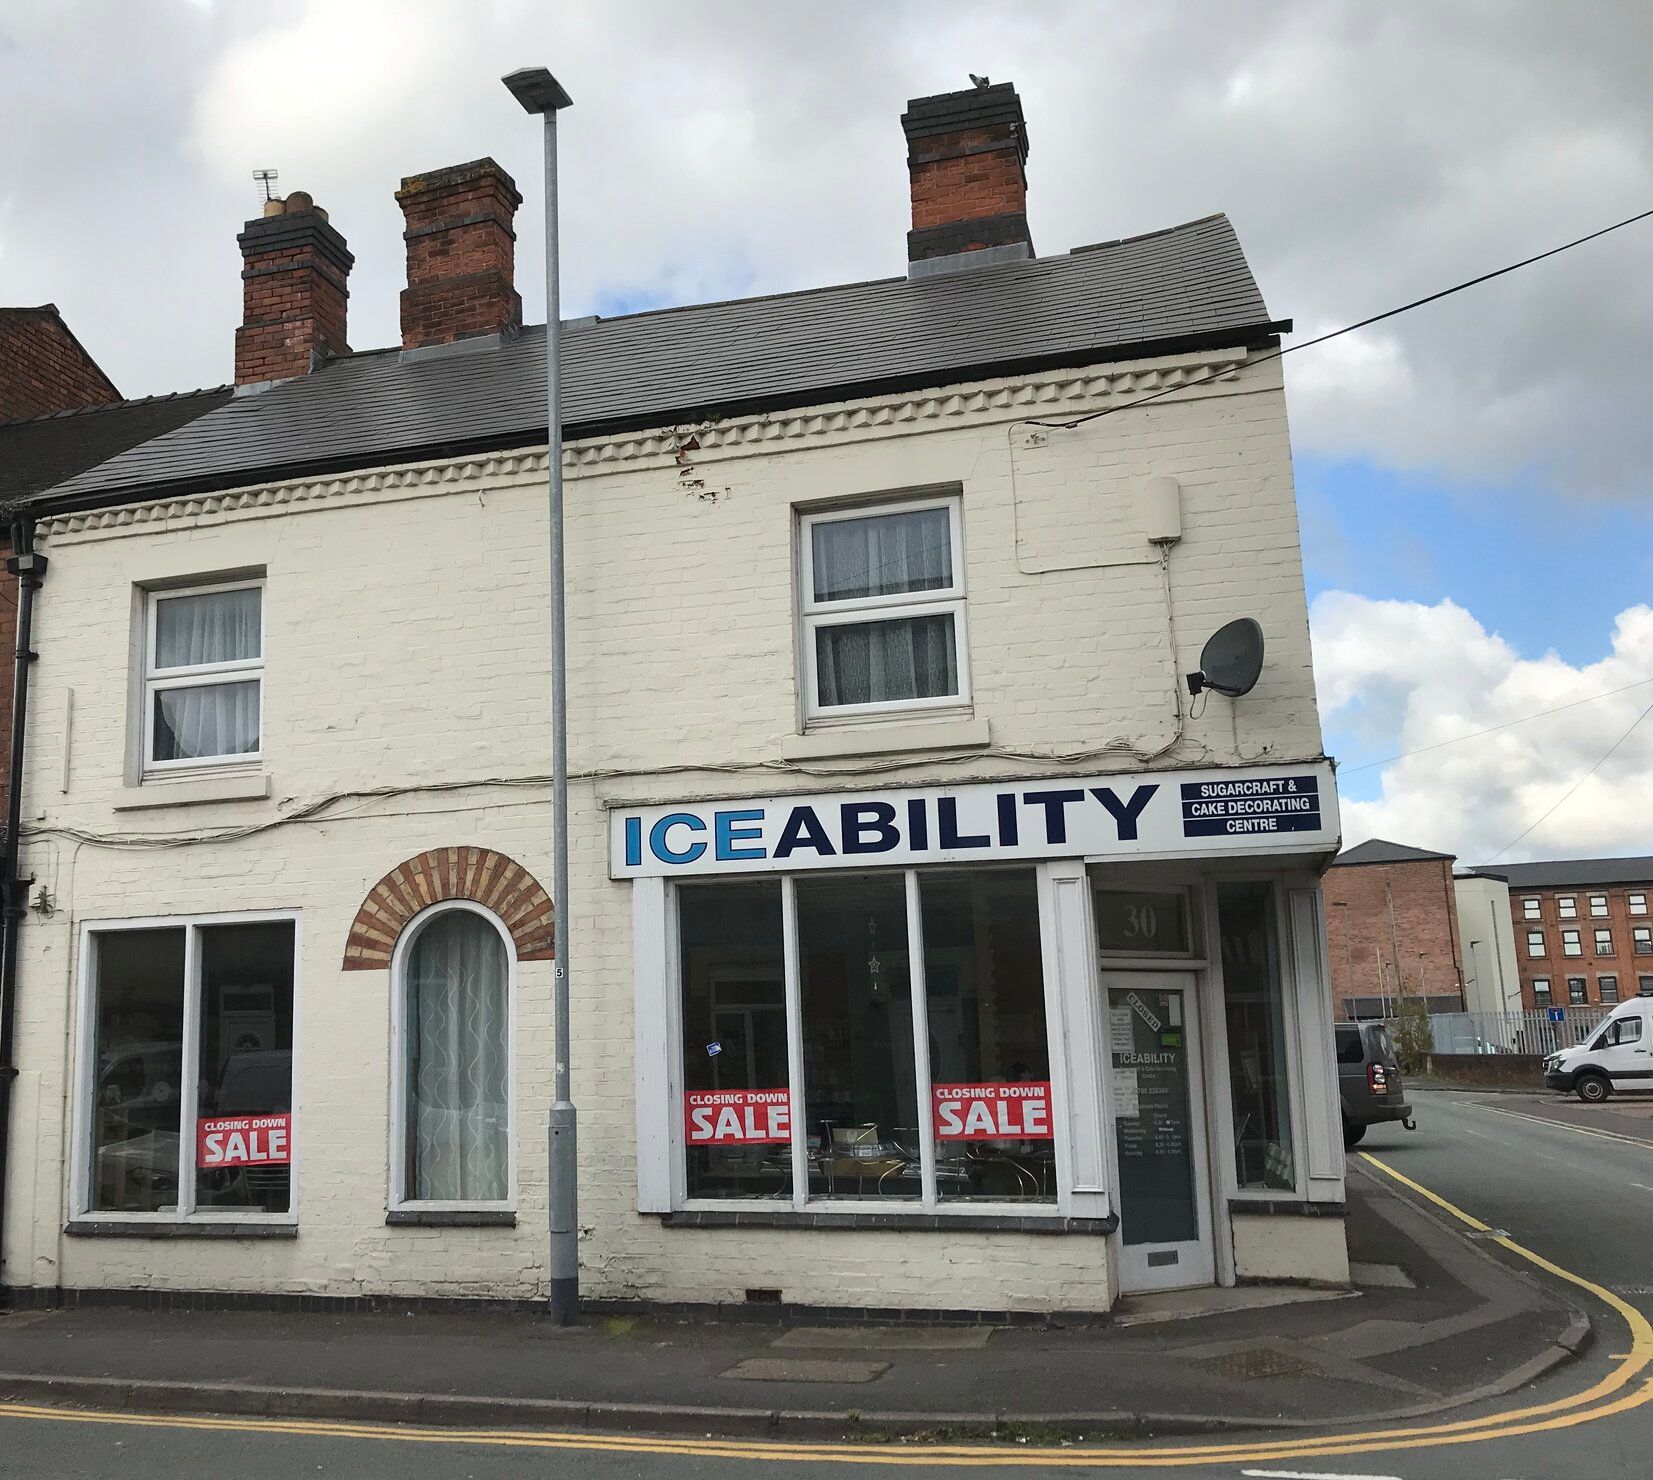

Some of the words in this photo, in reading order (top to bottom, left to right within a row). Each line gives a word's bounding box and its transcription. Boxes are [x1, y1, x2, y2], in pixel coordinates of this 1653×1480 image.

[1201, 781, 1284, 797] SUGARCRAFT
[1288, 780, 1297, 792] &
[1191, 802, 1226, 816] CAKE
[1228, 797, 1310, 814] DECORATING
[625, 784, 1161, 867] ICEABILITY
[1226, 818, 1277, 832] CENTRE
[1123, 904, 1157, 938] 30
[556, 968, 563, 977] 5
[1128, 994, 1160, 1030] CLOSED
[1120, 1053, 1176, 1064] ICEABILITY
[690, 1094, 743, 1105] CLOSING
[747, 1092, 788, 1103] DOWN
[936, 1087, 996, 1099] CLOSING
[1000, 1086, 1044, 1097] DOWN
[204, 1120, 249, 1131] CLOSING
[252, 1118, 286, 1128] DOWN
[691, 1105, 790, 1140] SALE
[938, 1100, 1048, 1135] SALE
[204, 1130, 287, 1163] SALE
